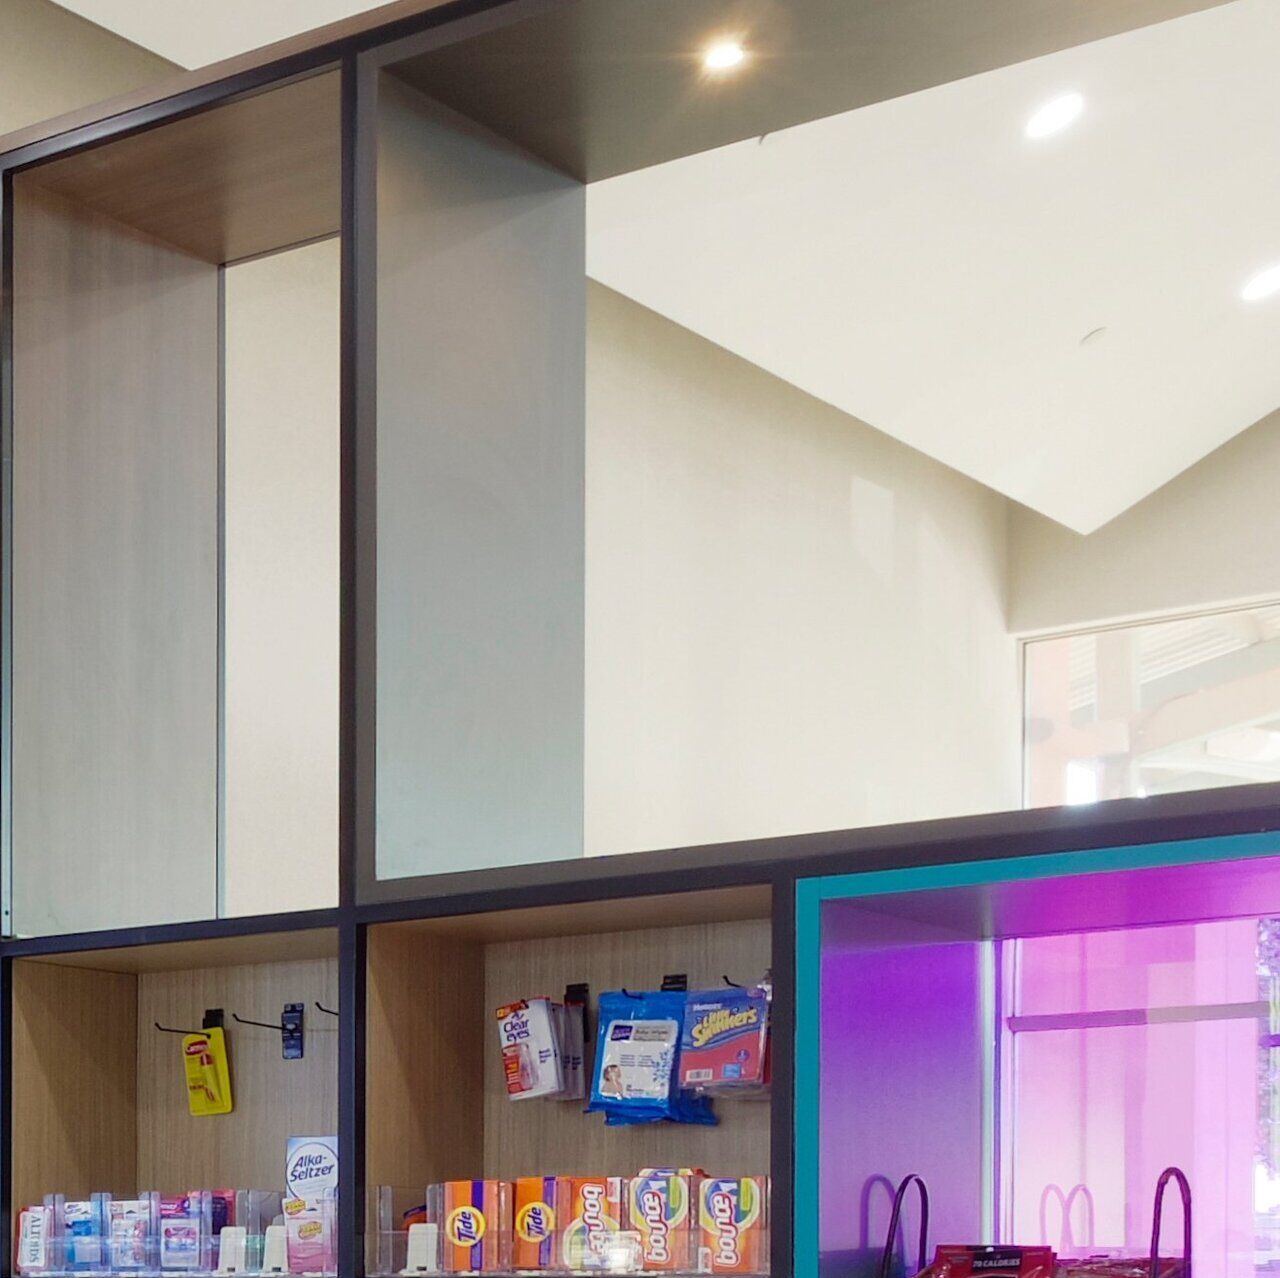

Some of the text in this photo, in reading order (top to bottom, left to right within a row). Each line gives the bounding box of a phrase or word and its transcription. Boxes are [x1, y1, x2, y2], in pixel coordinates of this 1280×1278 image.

[503, 1020, 529, 1034] Clear
[506, 1028, 530, 1042] eyes
[290, 1165, 335, 1183] Seltzer
[294, 1153, 327, 1170] Alka-
[456, 1211, 475, 1243] Tide
[526, 1206, 543, 1239] Tide
[644, 1192, 669, 1263] bounce
[714, 1193, 737, 1267] bounce
[30, 1215, 40, 1264] ALTOIDS
[984, 1258, 1021, 1267] CALORIES
